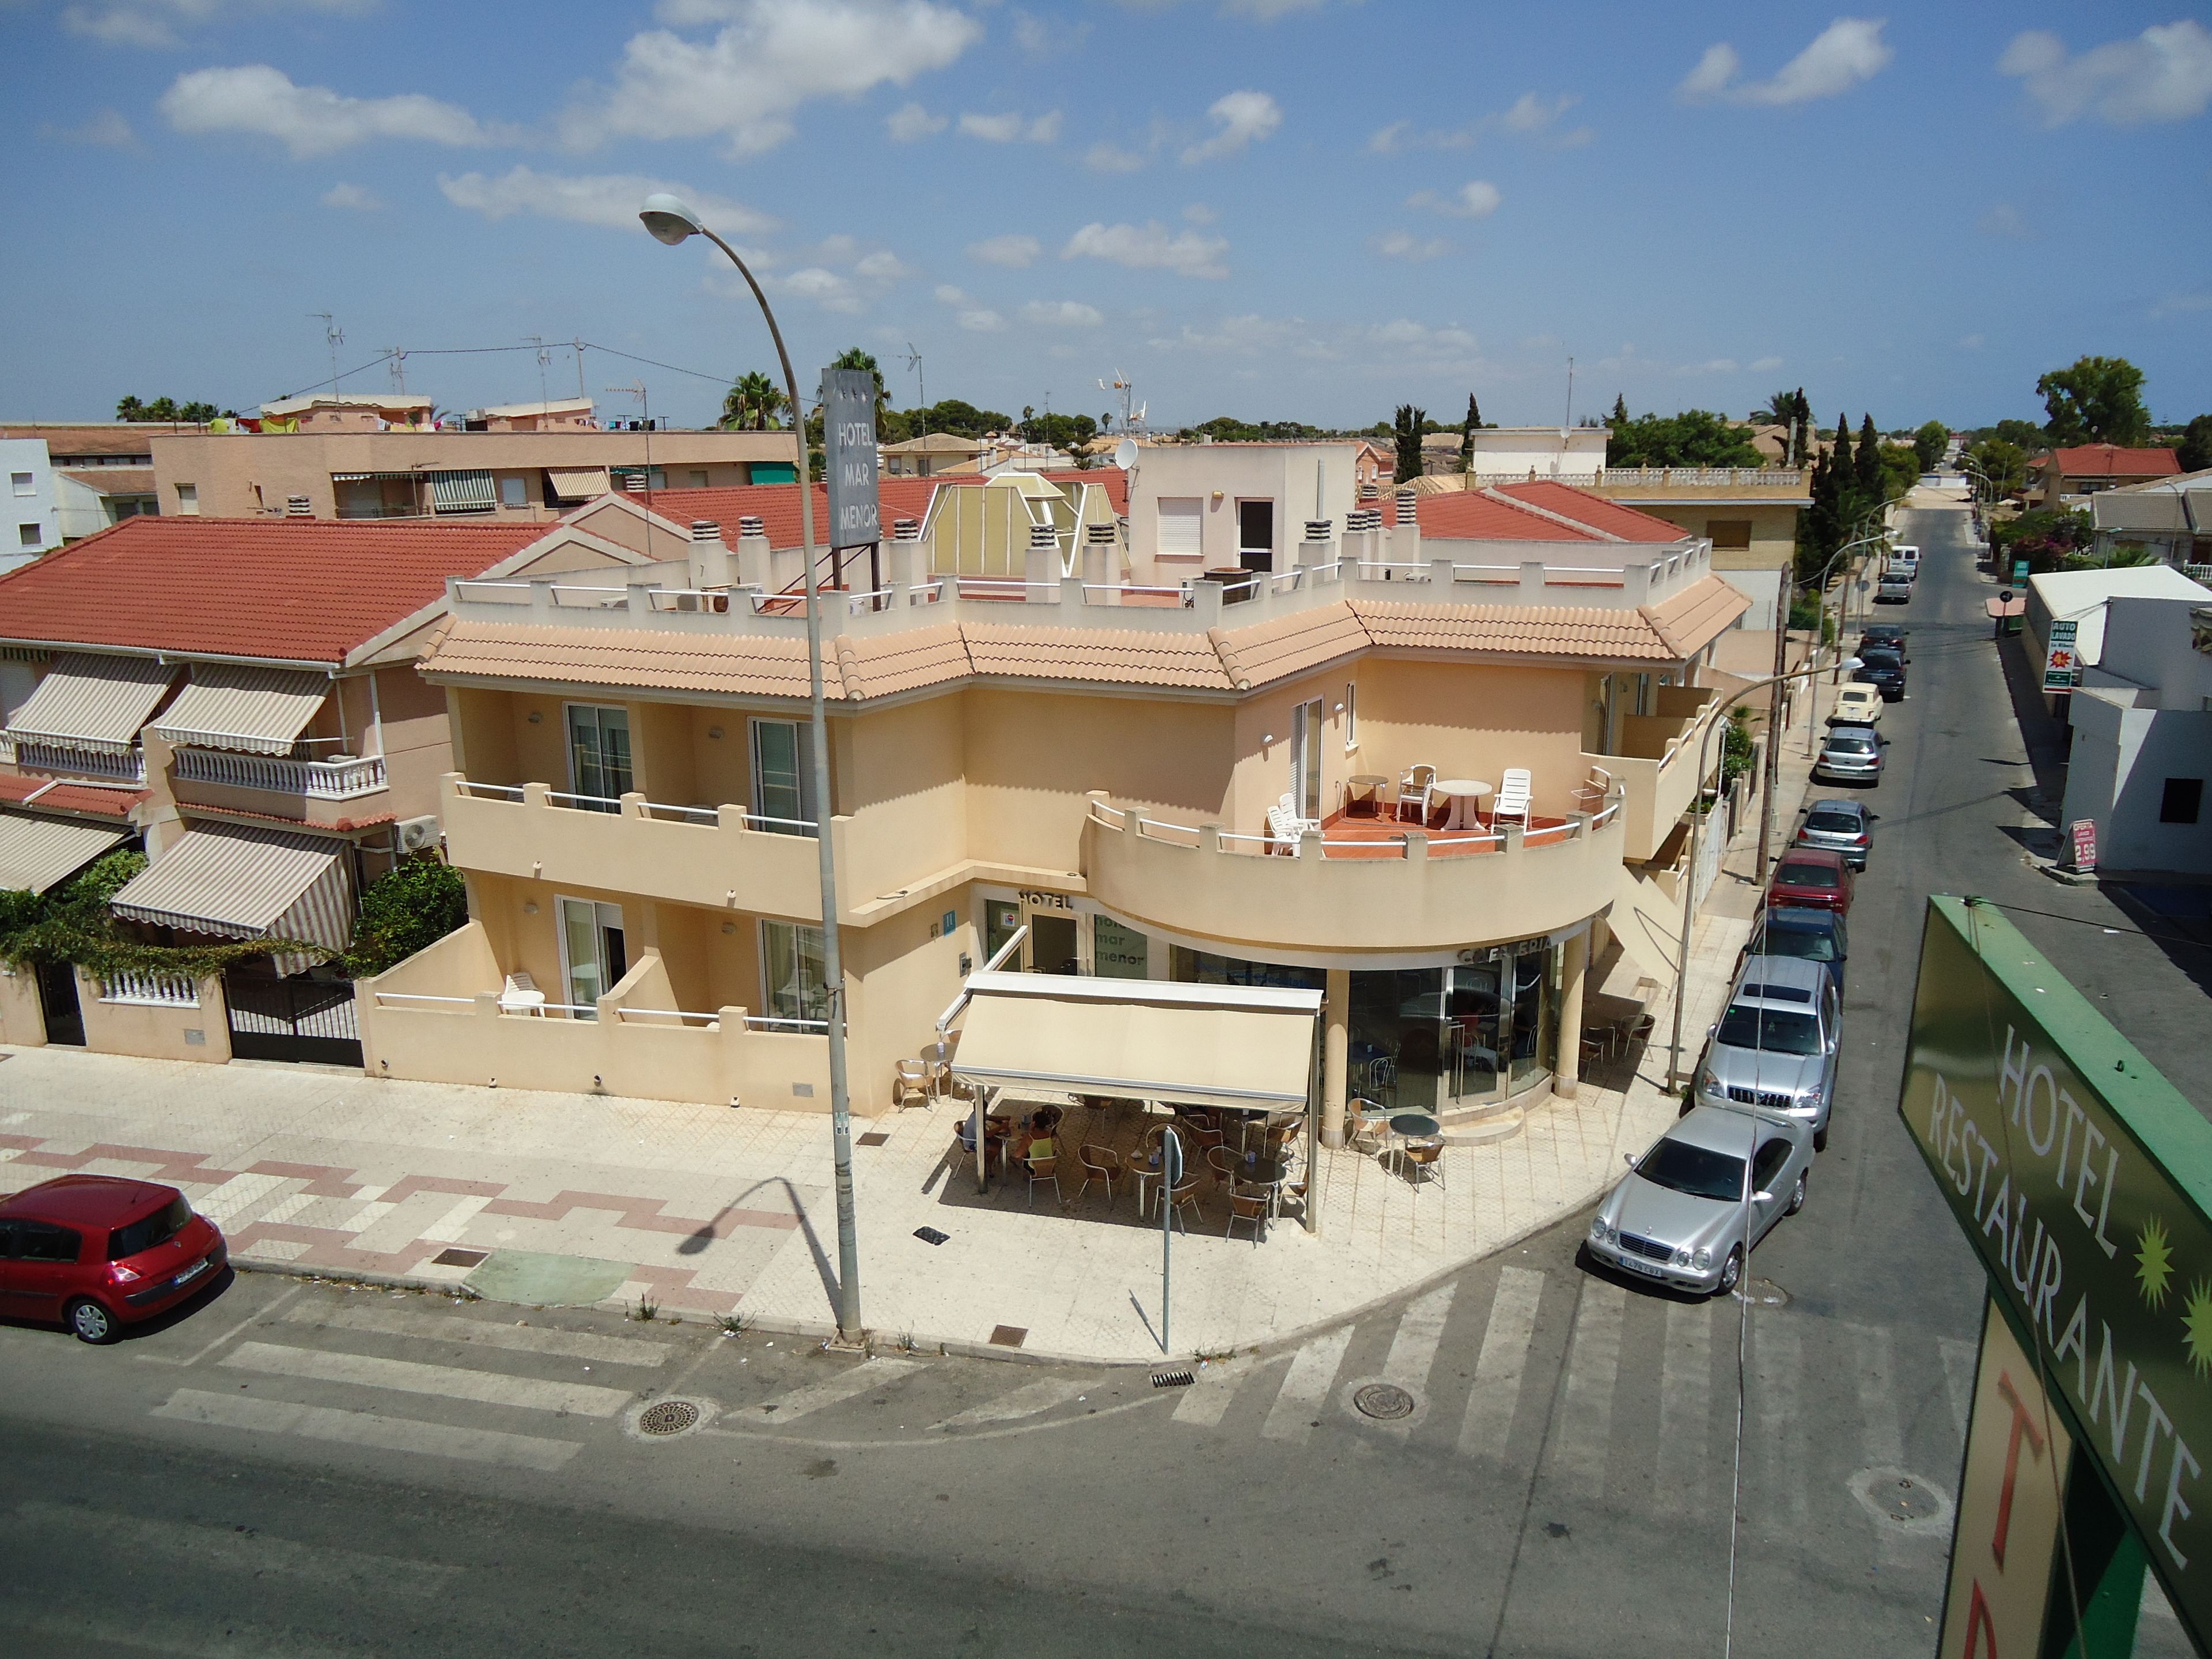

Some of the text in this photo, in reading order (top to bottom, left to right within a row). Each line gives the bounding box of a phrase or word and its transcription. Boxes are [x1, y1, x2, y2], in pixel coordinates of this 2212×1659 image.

[839, 422, 873, 446] HOTEL
[845, 463, 869, 486] MAR
[840, 504, 878, 530] MENOR
[2051, 631, 2075, 641] LAVADO
[2053, 622, 2075, 631] AUTO
[1018, 893, 1073, 910] HOTEL
[1096, 933, 1126, 945] mar
[1096, 950, 1144, 965] menor
[1997, 1024, 2120, 1259] HOTEL
[1928, 1072, 2202, 1571] RESTAURANTE
